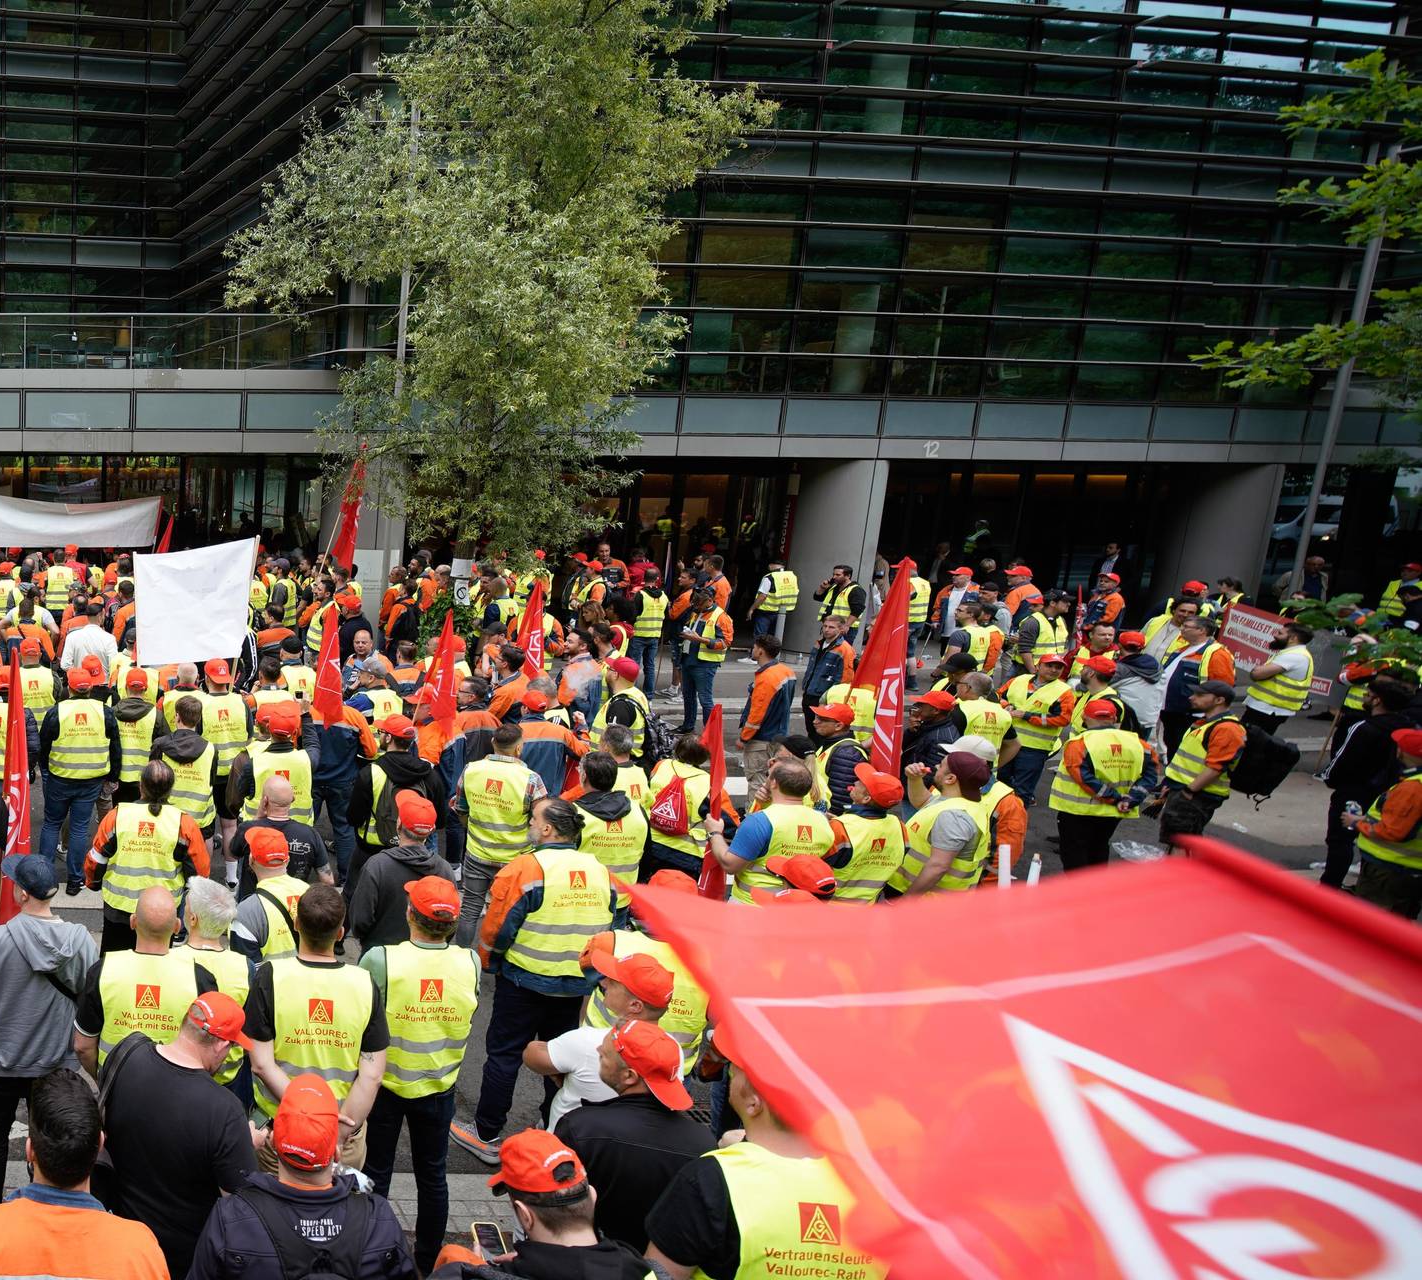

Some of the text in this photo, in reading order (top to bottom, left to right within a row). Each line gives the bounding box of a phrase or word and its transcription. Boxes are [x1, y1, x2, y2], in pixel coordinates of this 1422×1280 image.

[923, 440, 940, 458] 12
[778, 503, 791, 553] ACCUEIL
[404, 1005, 456, 1014] VALLOUREC
[672, 1007, 693, 1016] Stahl
[121, 1011, 174, 1023] VALLOUREC
[395, 1013, 463, 1023] Zukunft mit Stahl
[113, 1019, 143, 1030] Zukunft
[145, 1022, 160, 1030] mit
[294, 1028, 348, 1039] VALLOUREC
[317, 1038, 332, 1046] mit
[334, 1040, 355, 1049] Stahl
[301, 1226, 325, 1238] SPEED
[764, 1247, 874, 1265] Vertrauensleute
[765, 1262, 867, 1280] Vallourec-Rath
